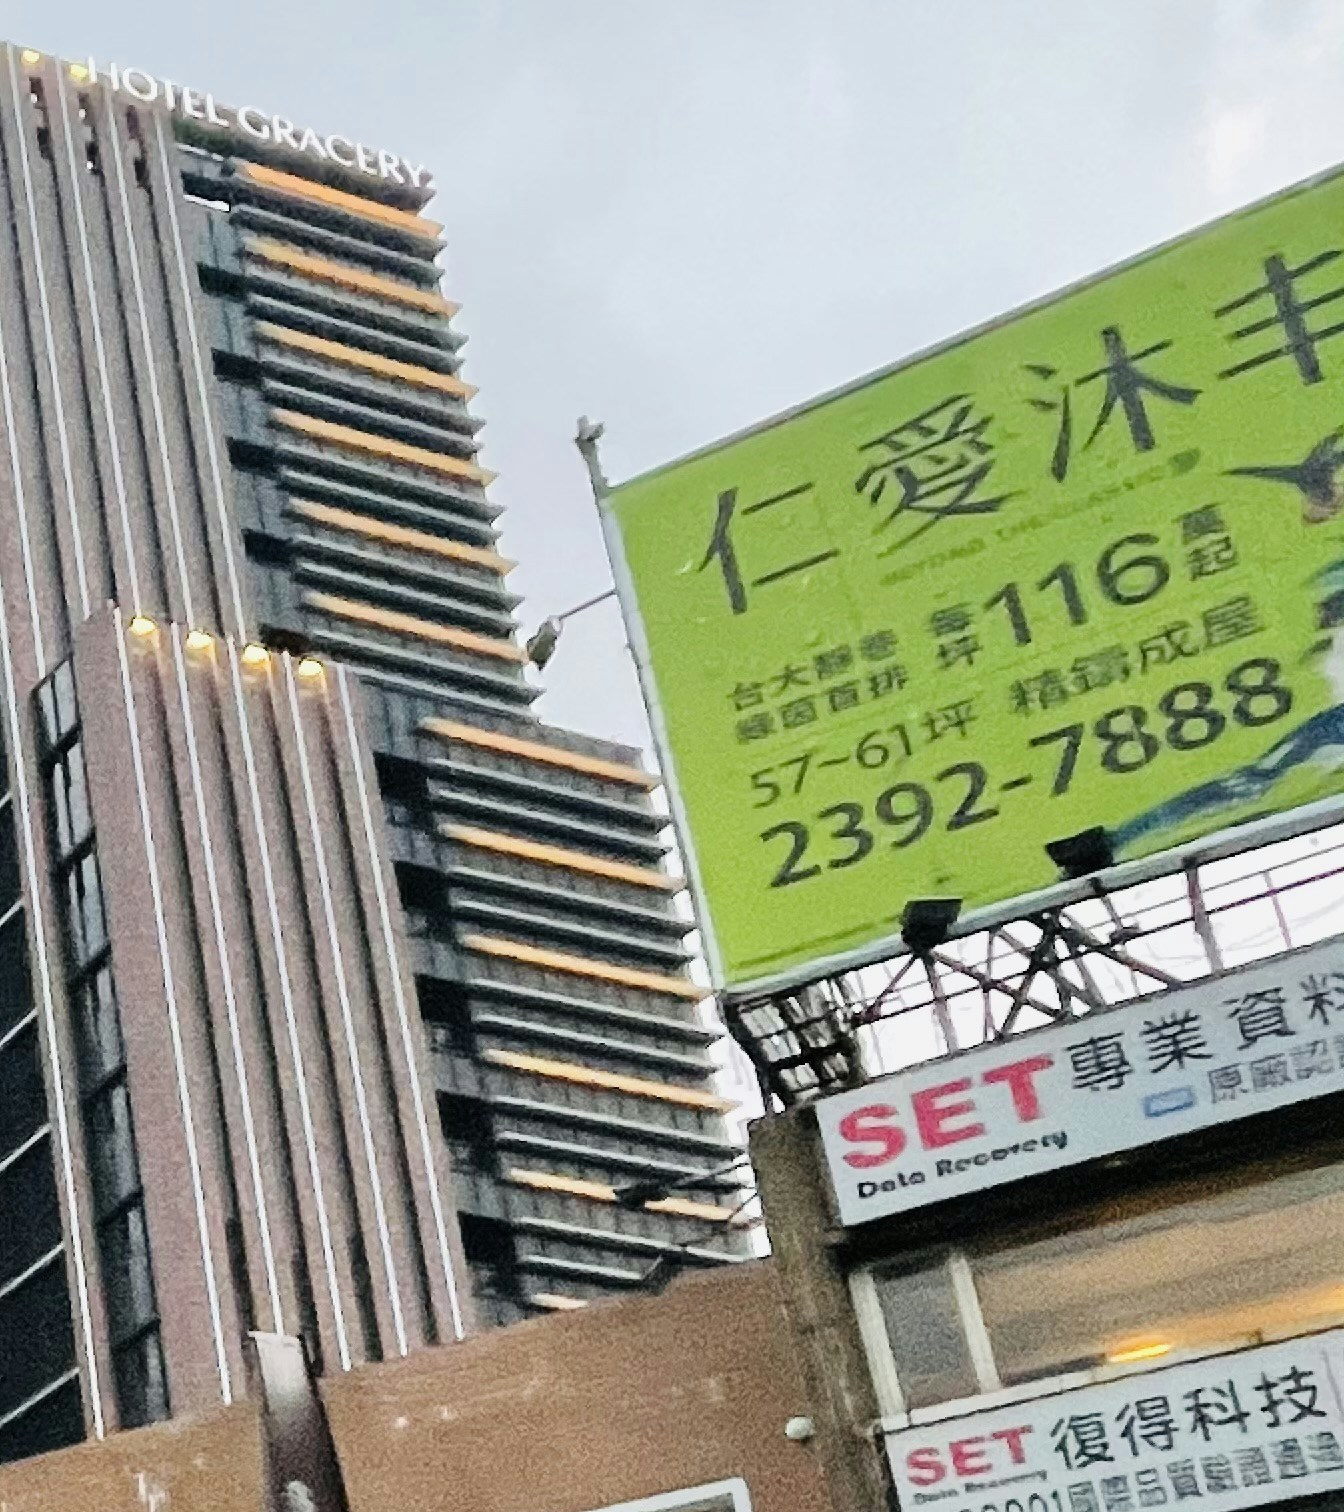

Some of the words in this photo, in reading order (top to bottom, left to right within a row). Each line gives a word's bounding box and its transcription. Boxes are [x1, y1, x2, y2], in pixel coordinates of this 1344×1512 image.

[88, 56, 232, 128] HOTEL
[237, 104, 430, 188] GRACERY
[982, 532, 1170, 646] 116
[760, 656, 1294, 888] 2392-7888
[838, 1053, 1055, 1170] SET
[857, 1168, 926, 1200] Data
[906, 1425, 1034, 1487] SET
[1050, 1364, 1328, 1471] 復得科技
